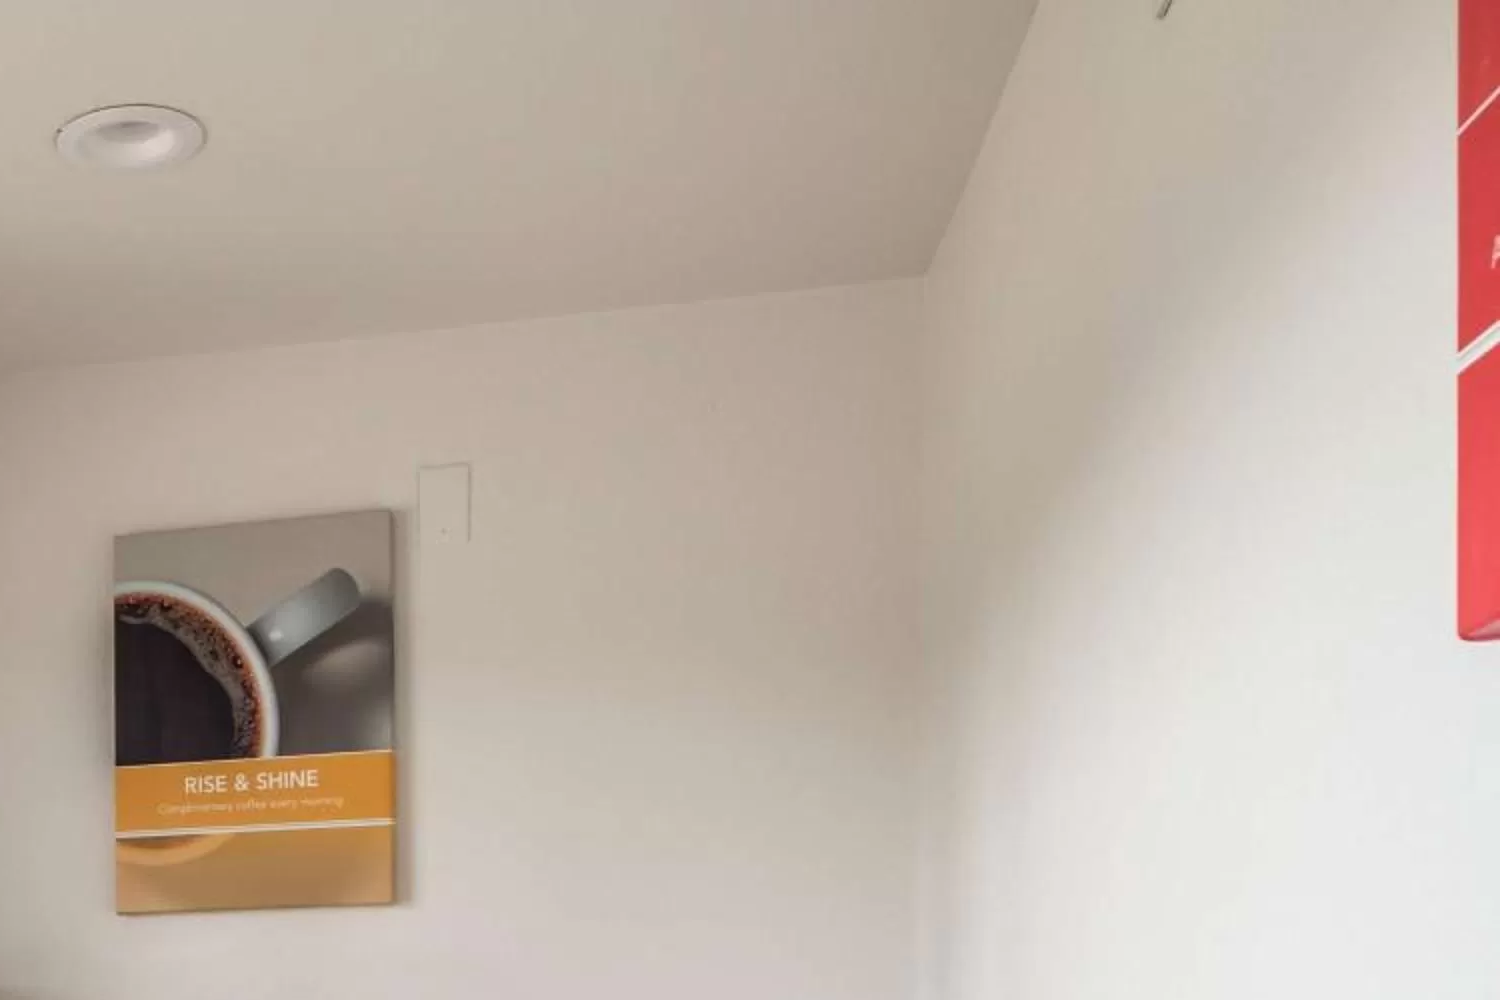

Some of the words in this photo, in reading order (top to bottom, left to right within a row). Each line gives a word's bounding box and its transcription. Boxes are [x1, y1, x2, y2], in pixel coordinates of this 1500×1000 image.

[184, 775, 228, 794] RISE
[234, 773, 250, 792] &
[256, 769, 320, 791] SHINE
